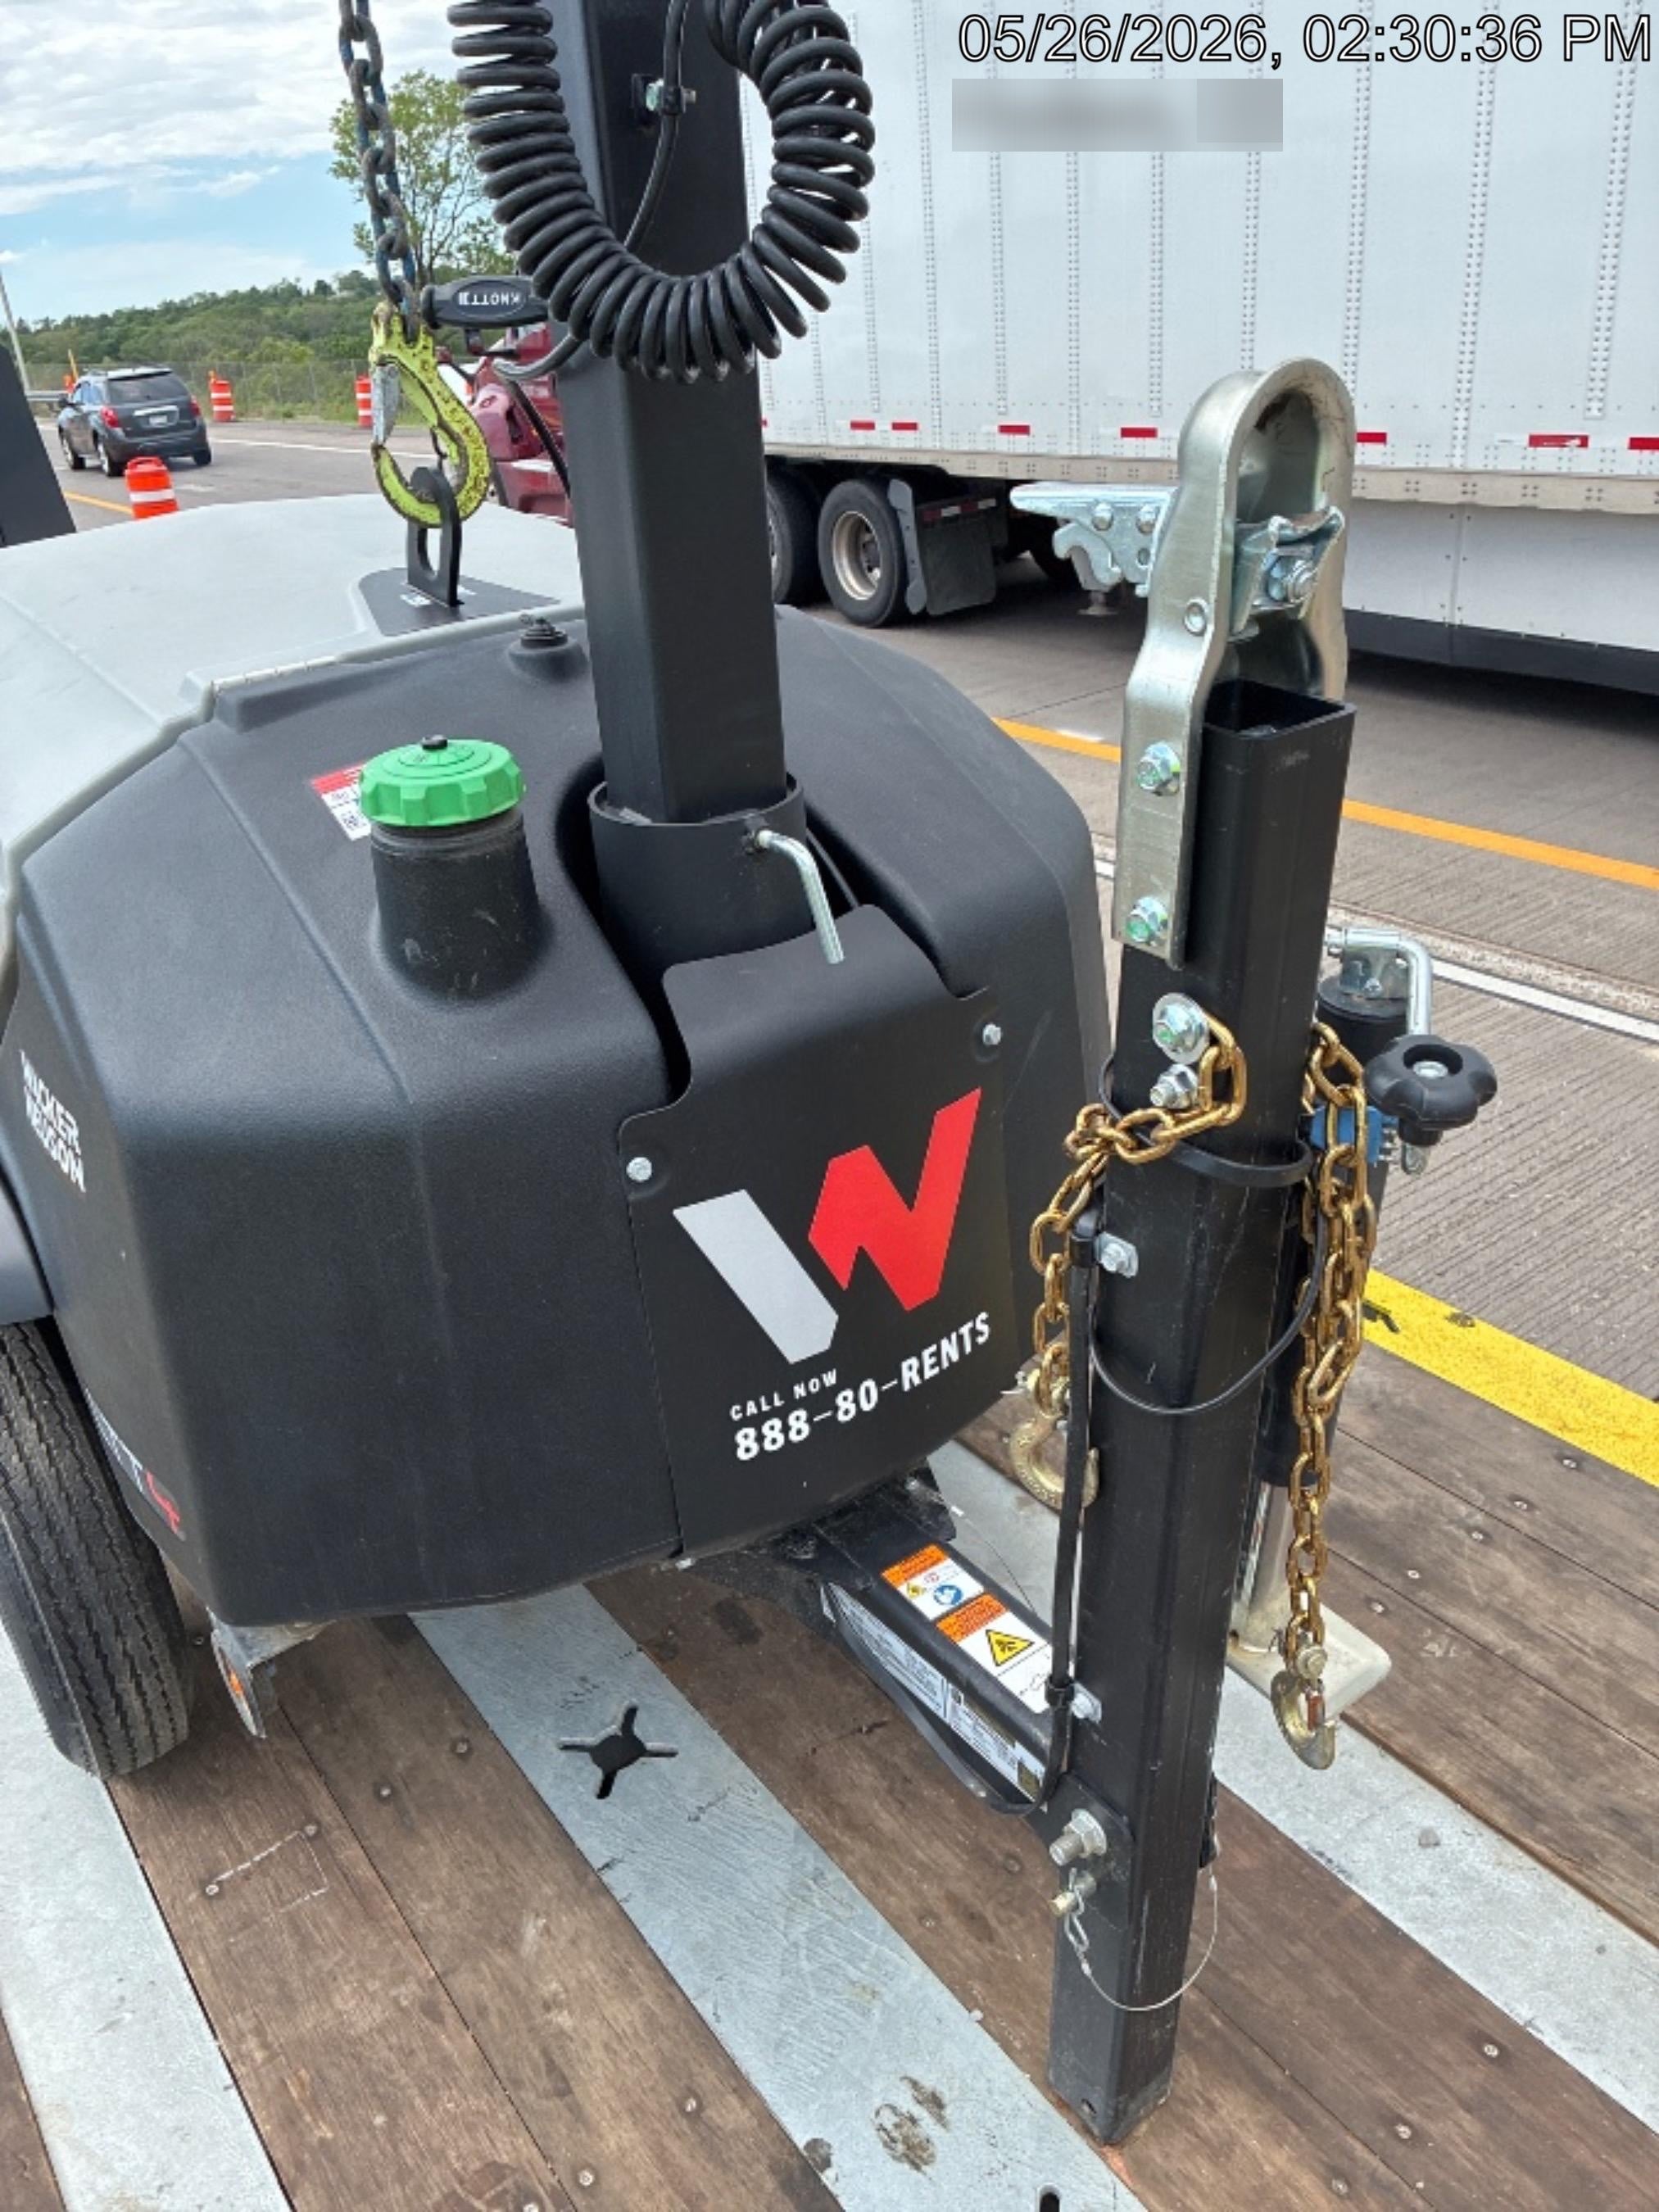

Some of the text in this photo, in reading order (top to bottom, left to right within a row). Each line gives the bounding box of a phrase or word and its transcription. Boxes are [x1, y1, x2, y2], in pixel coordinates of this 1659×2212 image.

[471, 291, 521, 306] KNOTT
[729, 1368, 838, 1421] CALL NOW
[734, 1312, 990, 1461] 888-80-RENTS
